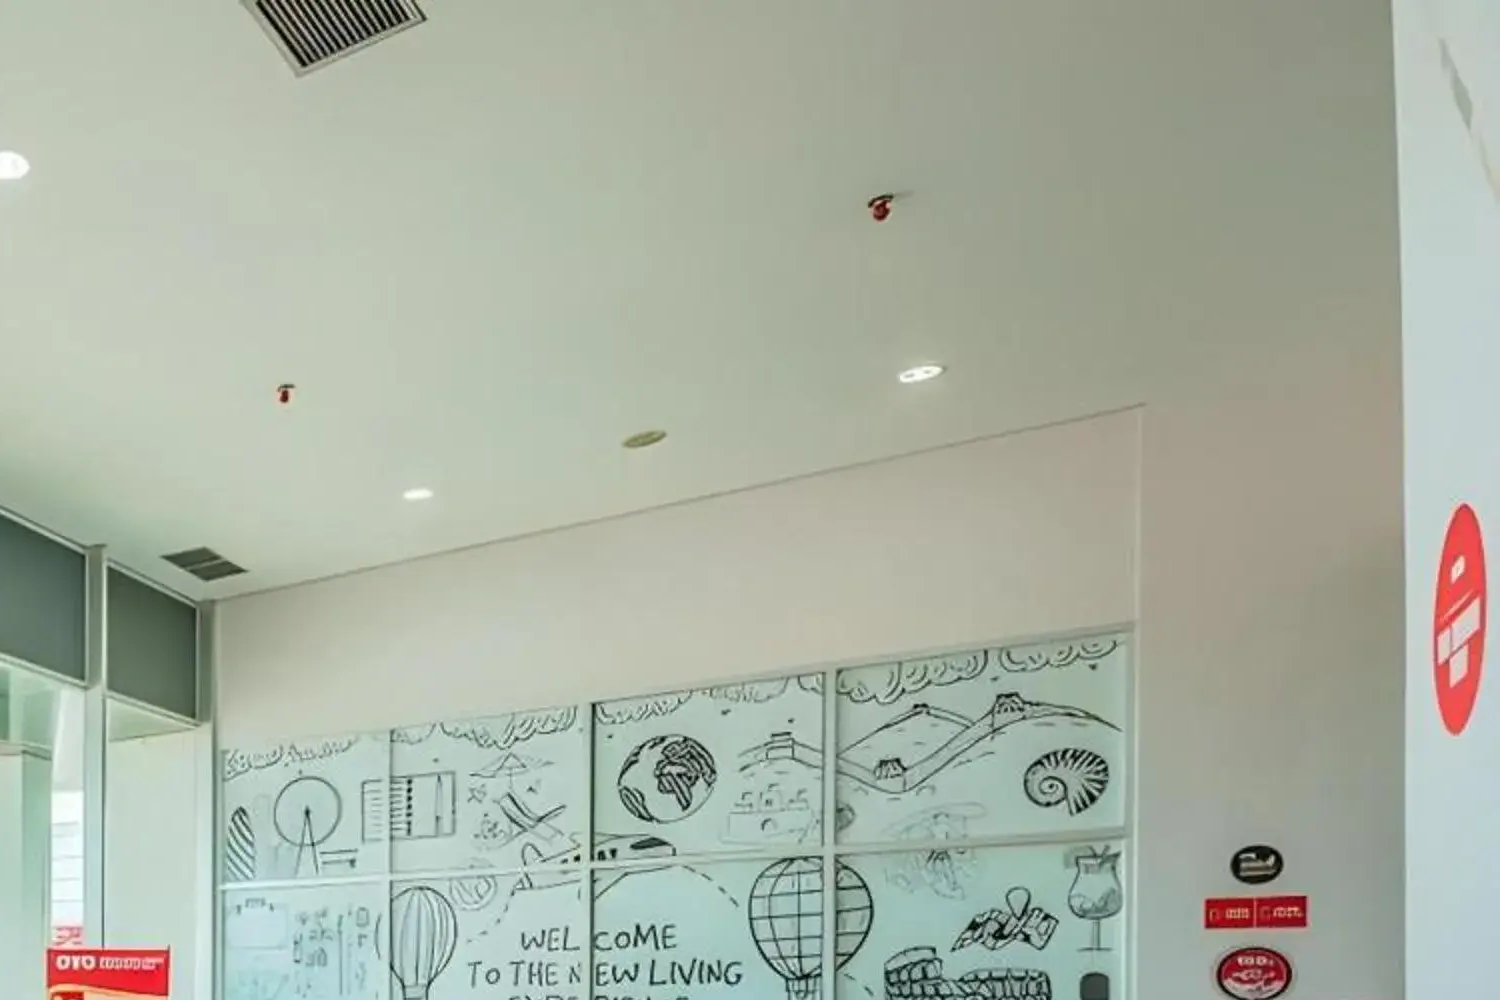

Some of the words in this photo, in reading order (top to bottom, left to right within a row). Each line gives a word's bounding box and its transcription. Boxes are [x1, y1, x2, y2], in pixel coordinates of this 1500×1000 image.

[521, 923, 678, 951] WELCOME
[56, 955, 97, 970] OYO
[468, 961, 501, 988] TO
[509, 959, 559, 987] THE
[569, 961, 640, 988] NEW
[649, 957, 744, 987] LIVING
